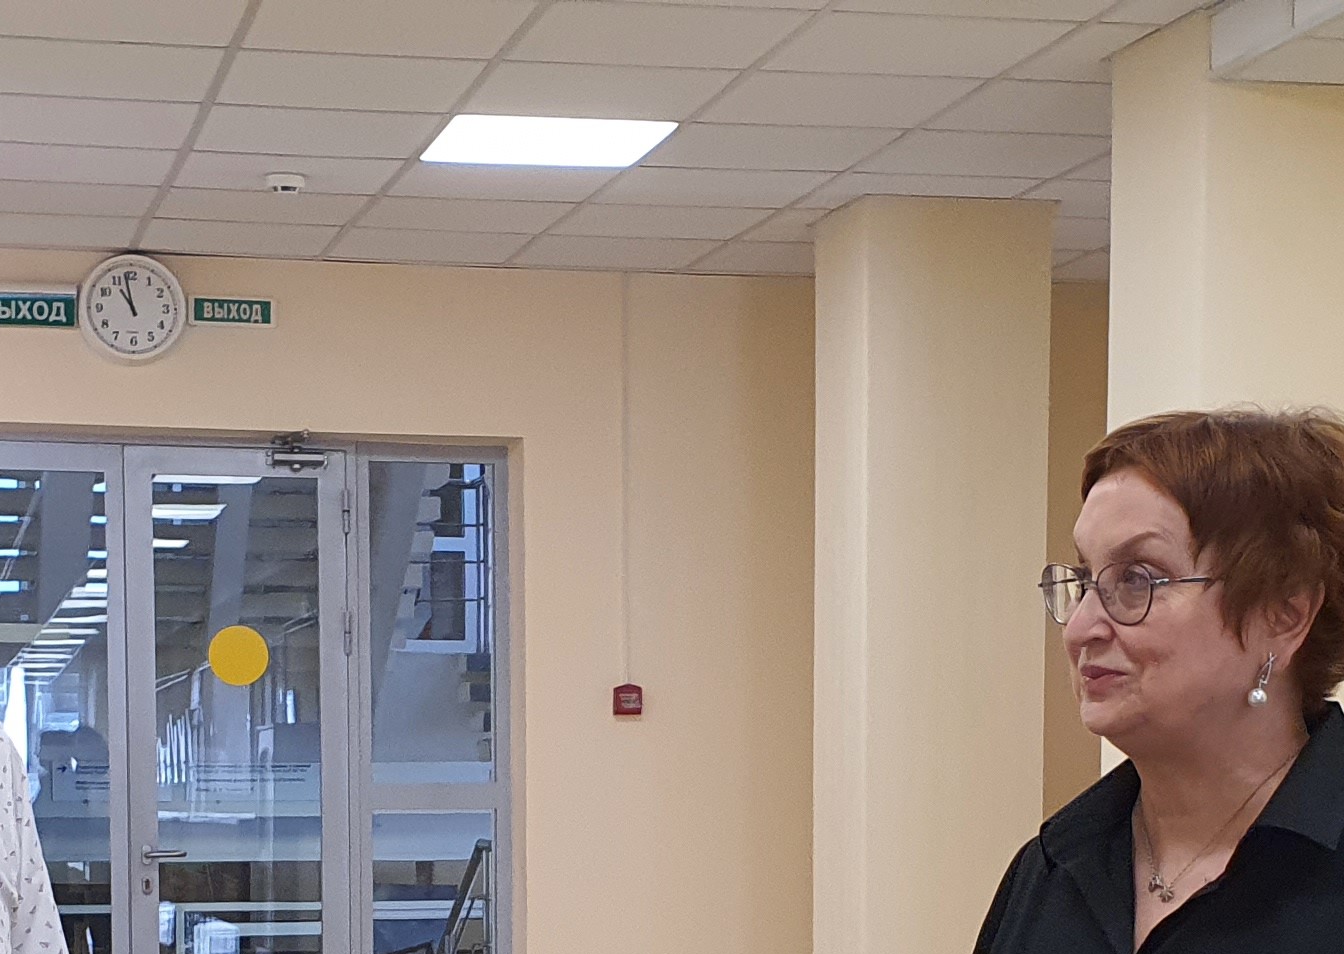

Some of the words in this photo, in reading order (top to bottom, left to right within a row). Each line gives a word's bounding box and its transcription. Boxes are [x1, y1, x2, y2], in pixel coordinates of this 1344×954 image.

[112, 275, 121, 286] 11
[146, 276, 152, 287] 1
[100, 287, 111, 297] 10
[157, 288, 164, 298] 2
[96, 303, 103, 313] 9
[162, 303, 170, 314] 3
[203, 301, 262, 323] ВЫХОД
[101, 319, 109, 329] 8
[157, 320, 165, 330] 4
[112, 331, 120, 341] 7
[147, 331, 155, 342] 5
[130, 336, 138, 347] 6
